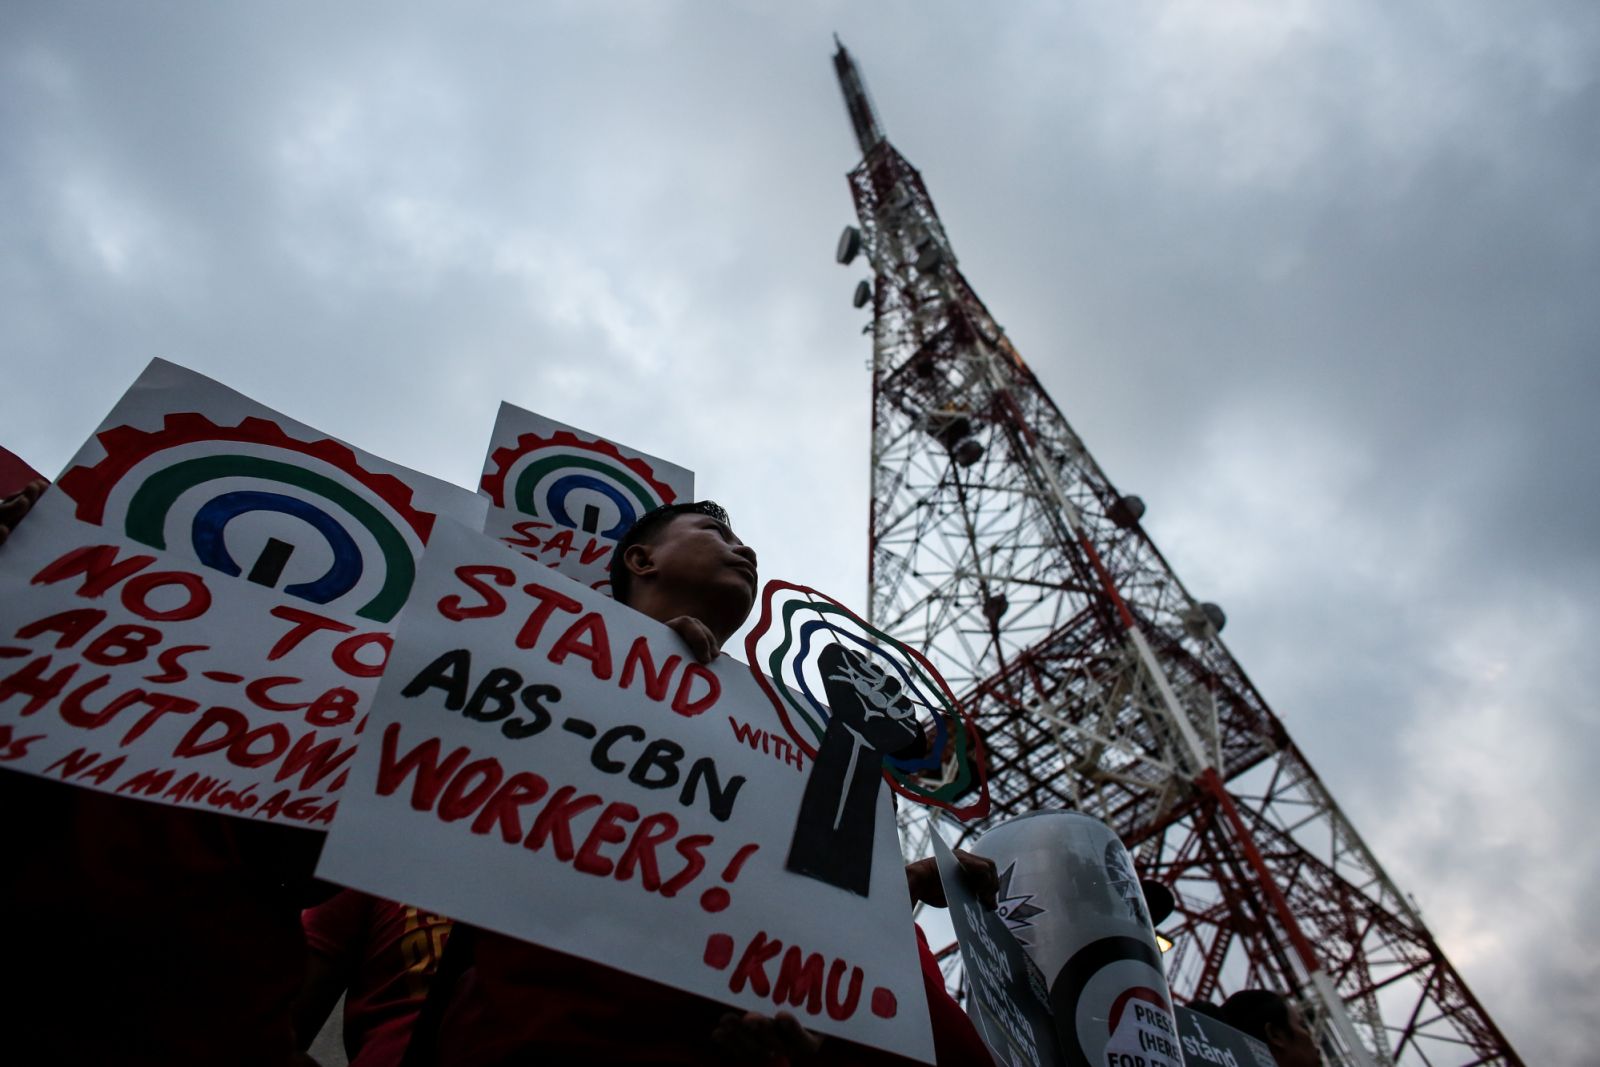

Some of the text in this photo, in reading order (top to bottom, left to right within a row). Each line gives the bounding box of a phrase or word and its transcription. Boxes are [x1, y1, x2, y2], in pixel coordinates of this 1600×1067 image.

[30, 544, 394, 677] NO TO
[500, 521, 612, 572] SAV
[14, 608, 369, 735] ABS-CB
[400, 648, 746, 821] ABS-CBN
[437, 565, 721, 717] STAND
[728, 715, 803, 772] WITH
[376, 723, 760, 913] WORKERS!
[1182, 1035, 1239, 1067] stand
